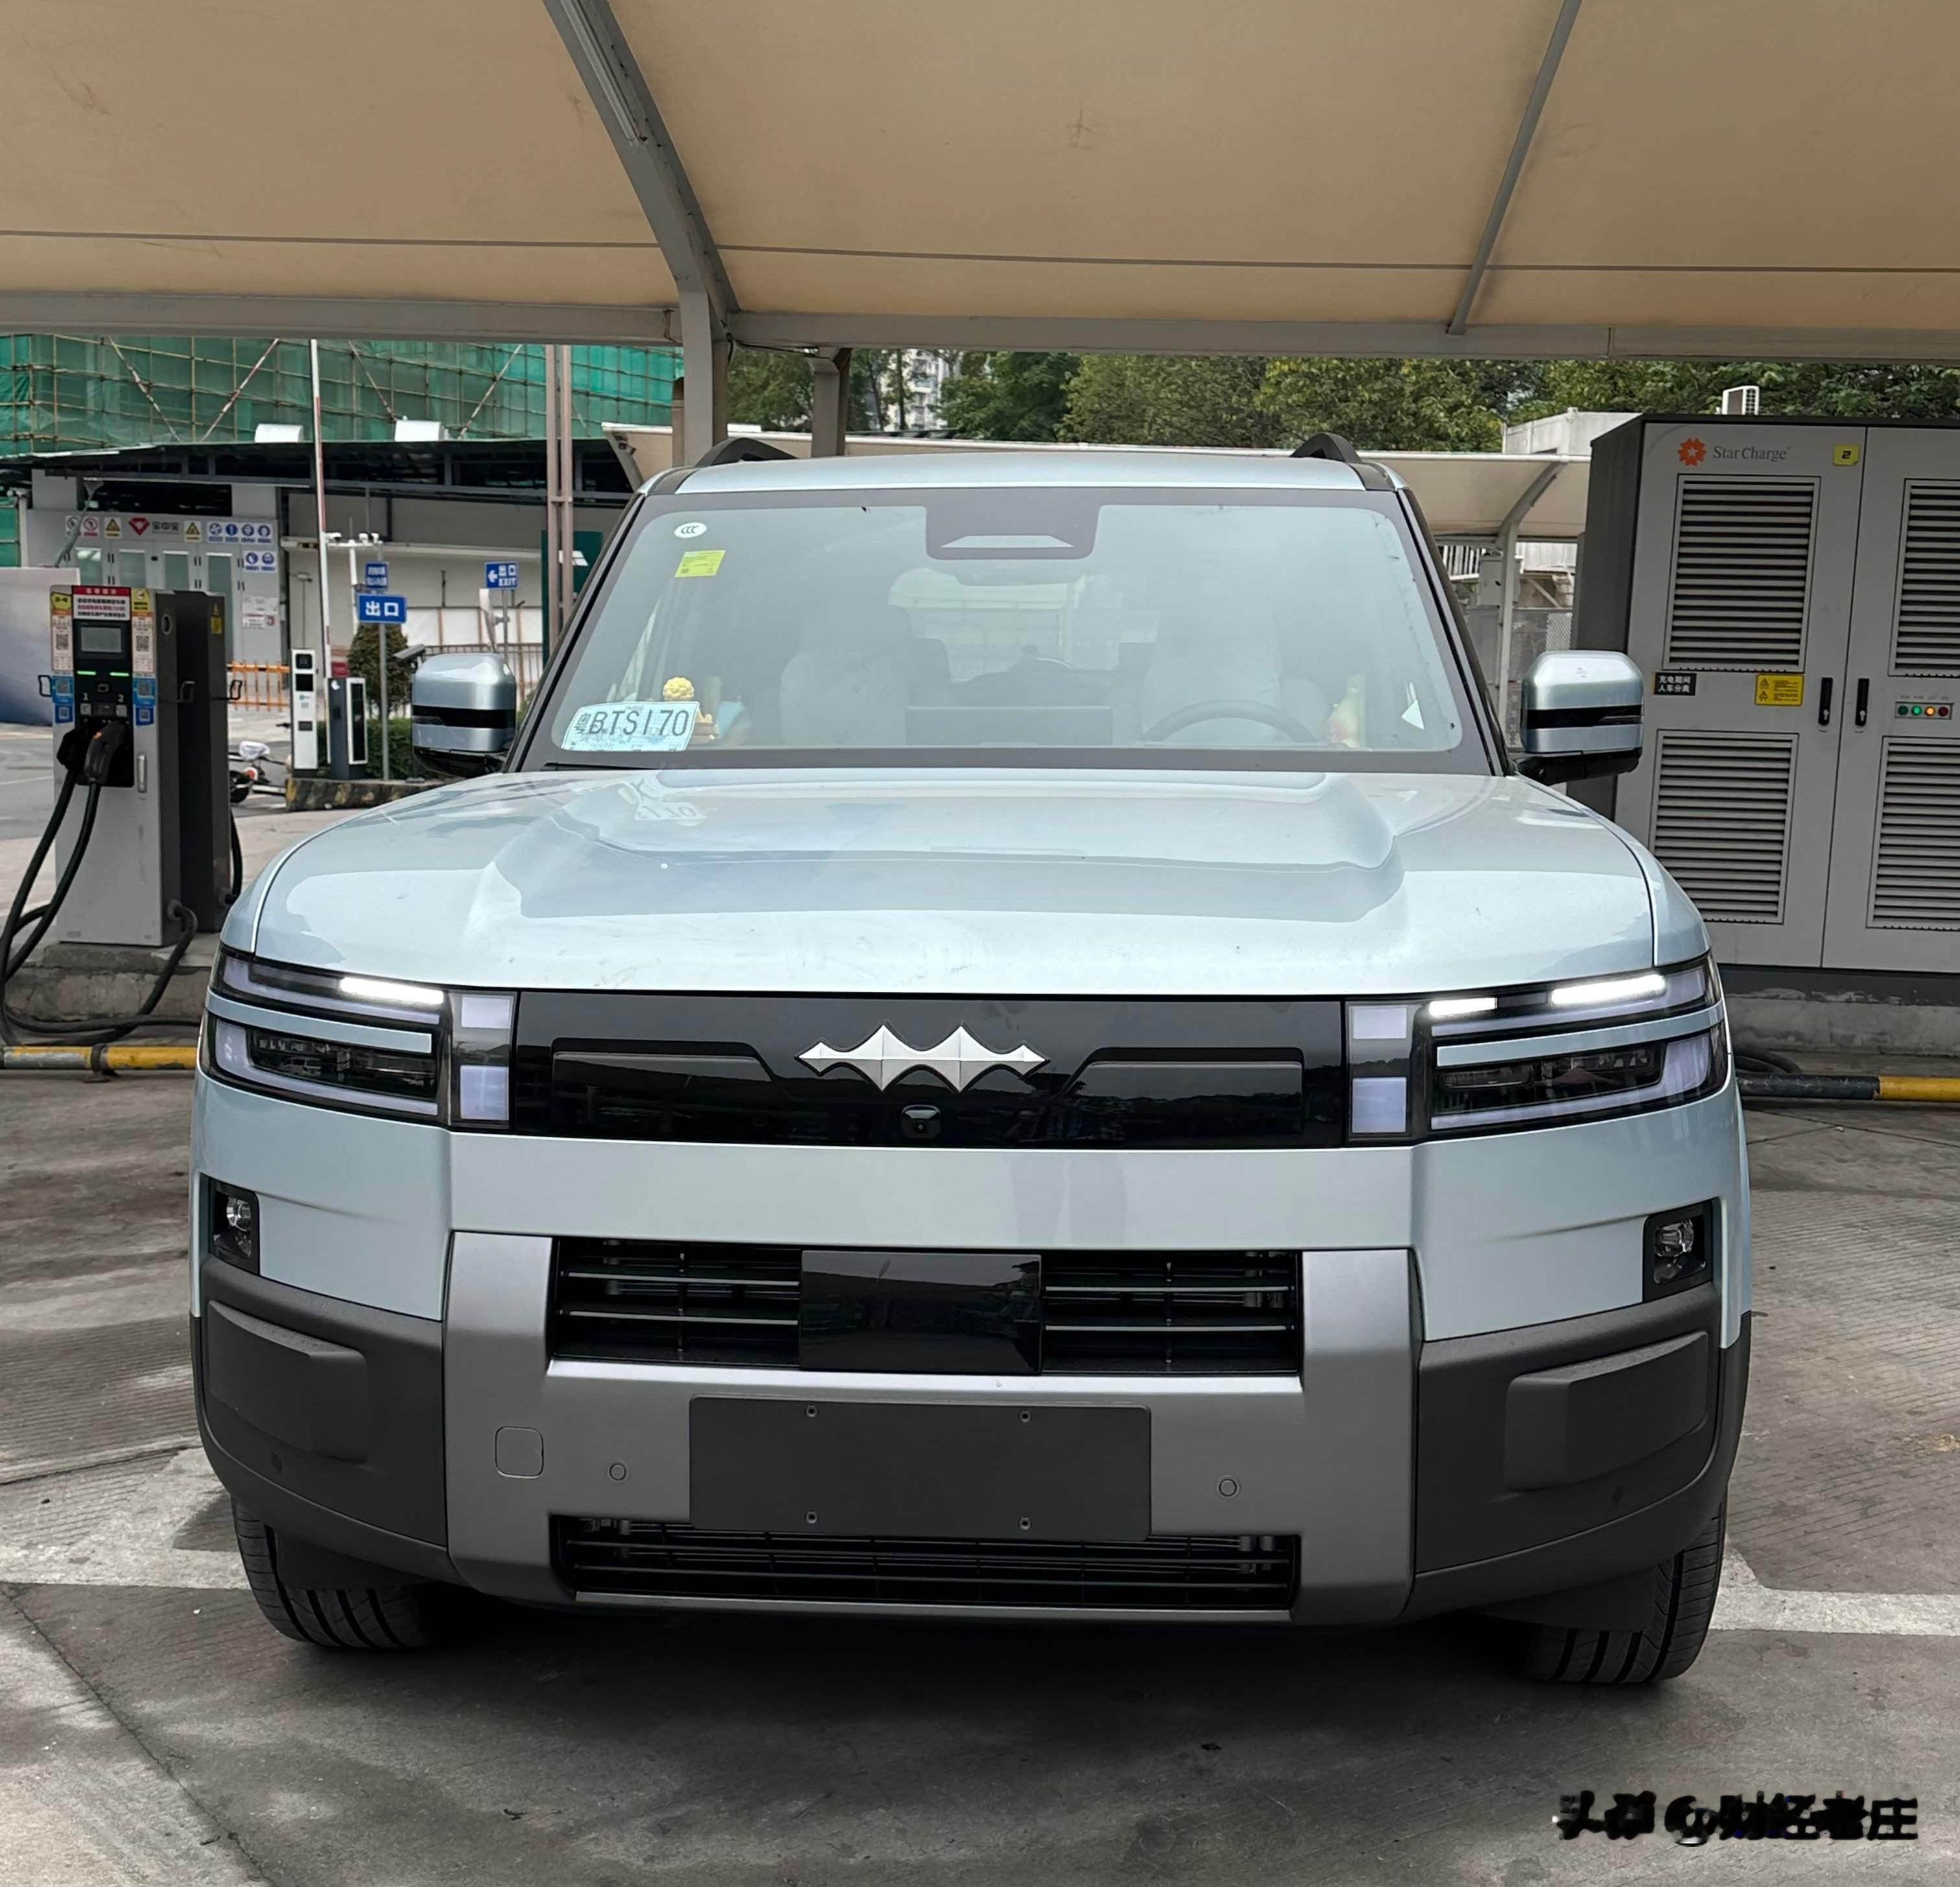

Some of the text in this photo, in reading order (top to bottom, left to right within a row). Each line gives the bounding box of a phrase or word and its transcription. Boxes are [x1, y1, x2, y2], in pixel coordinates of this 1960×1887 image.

[1713, 446, 1787, 462] Star Charge
[1841, 450, 1852, 459] 2
[499, 565, 517, 576] 出口
[499, 578, 517, 587] EXIT
[365, 600, 399, 617] 出口
[1659, 675, 1691, 684] 充电期间
[1658, 684, 1690, 693] 人车分离
